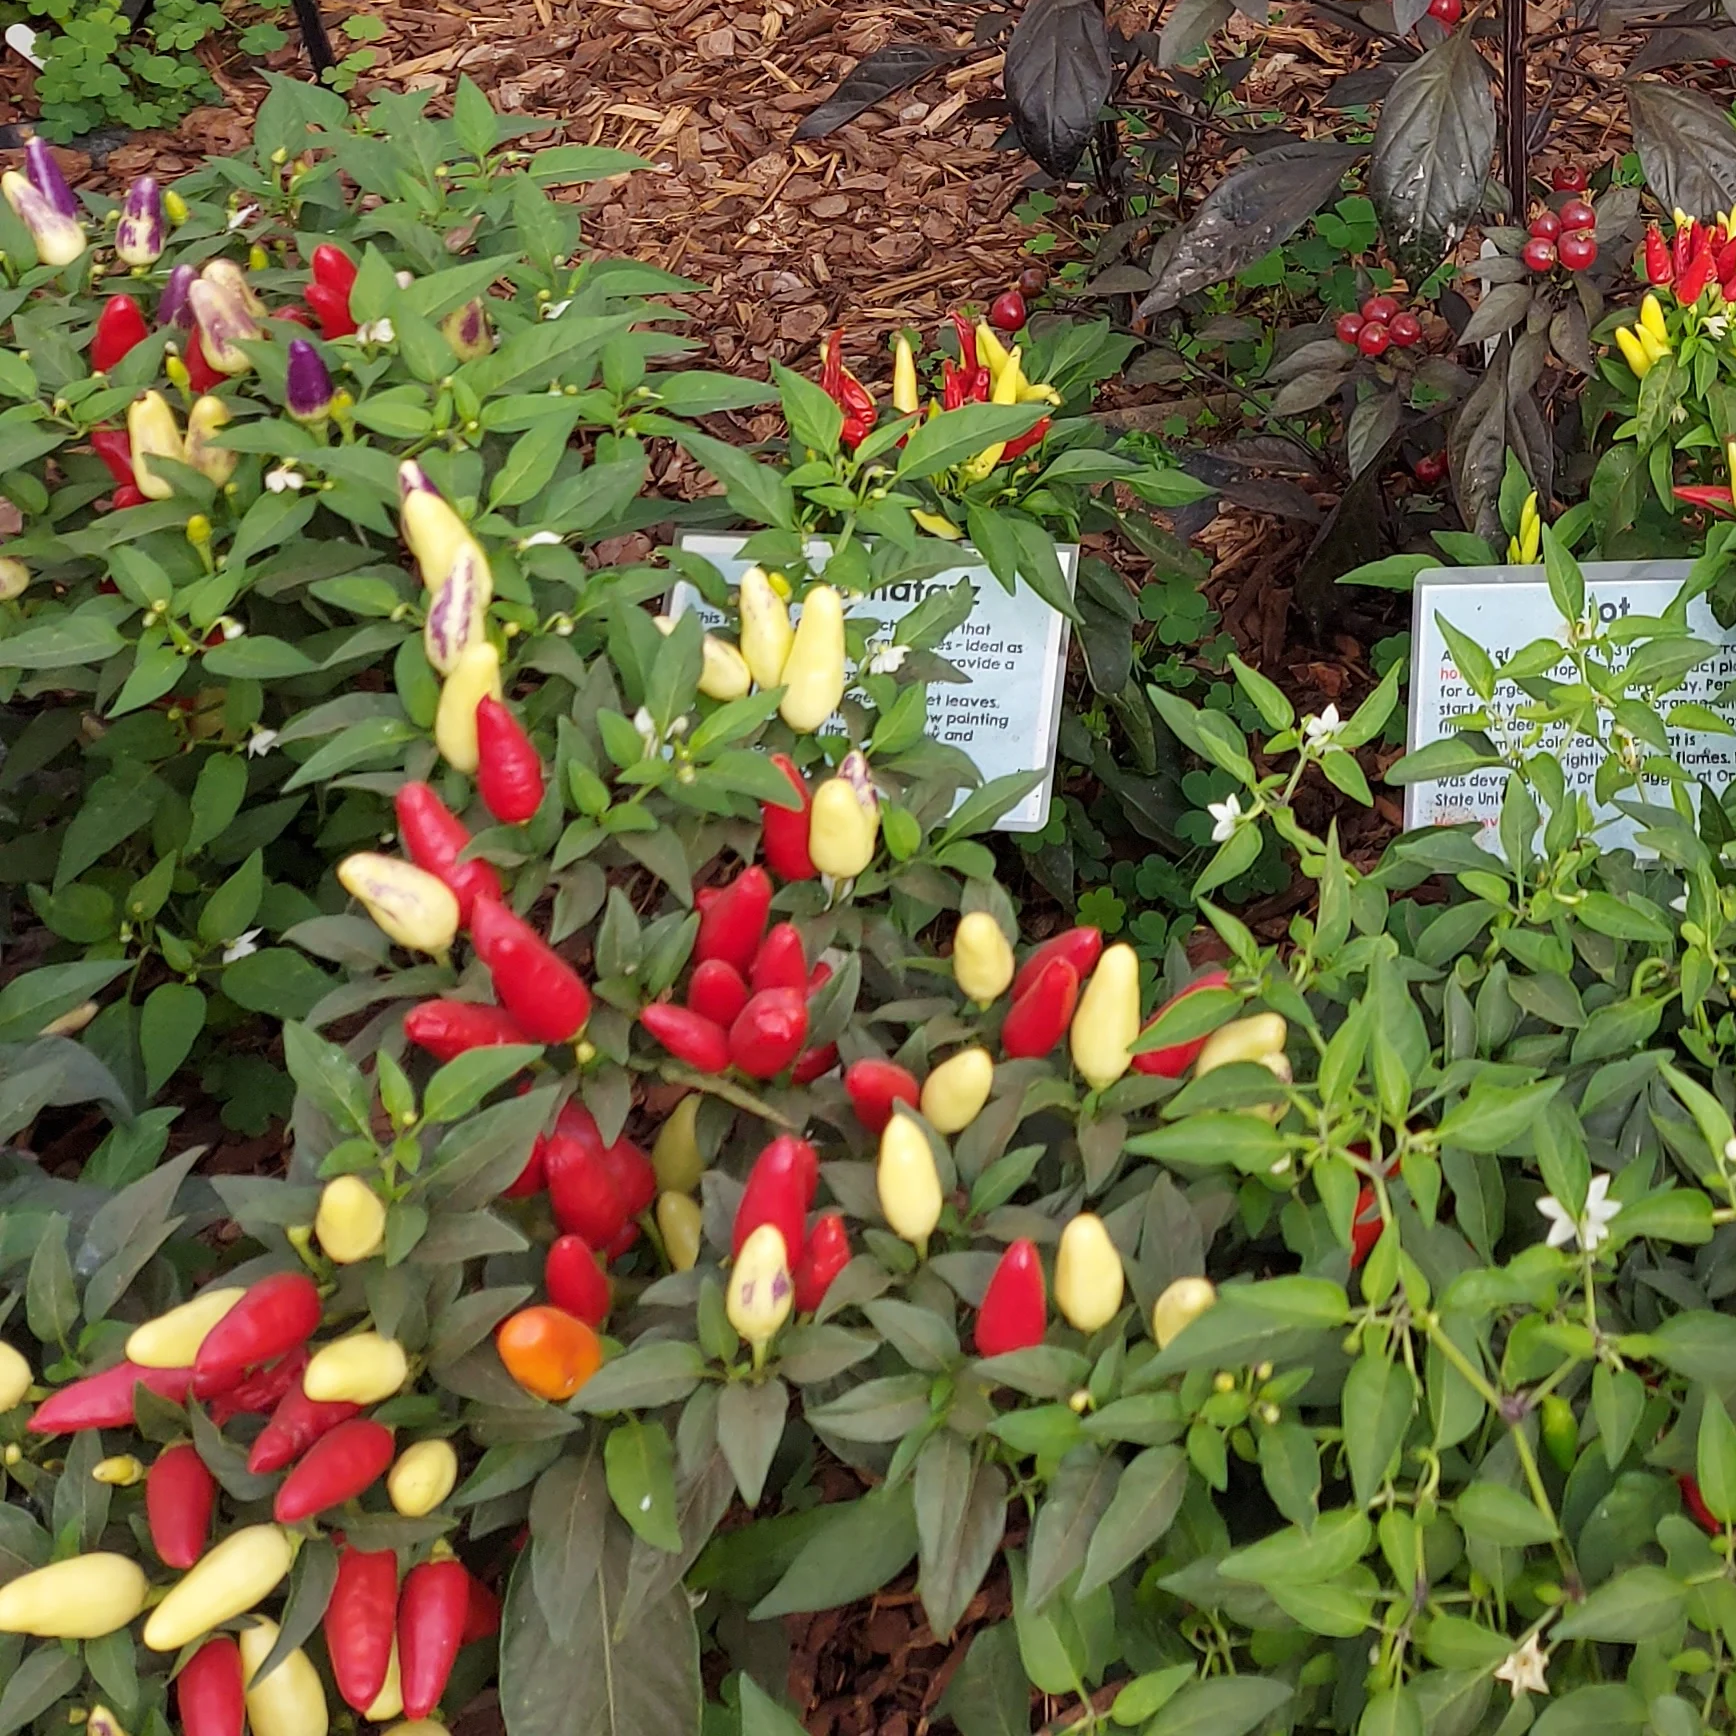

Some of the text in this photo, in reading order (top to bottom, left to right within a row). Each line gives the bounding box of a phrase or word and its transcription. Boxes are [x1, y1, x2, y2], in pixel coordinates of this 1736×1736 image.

[966, 640, 1003, 653] ideal
[1007, 643, 1023, 654] as
[950, 657, 1015, 670] rovide a
[1440, 685, 1462, 697] for
[1439, 704, 1473, 715] start
[946, 712, 1009, 729] painting
[944, 730, 973, 742] and
[1684, 734, 1696, 746] is
[1676, 751, 1731, 765] flames.
[1437, 776, 1466, 788] was
[1577, 772, 1595, 784] Dr
[1435, 793, 1474, 807] State
